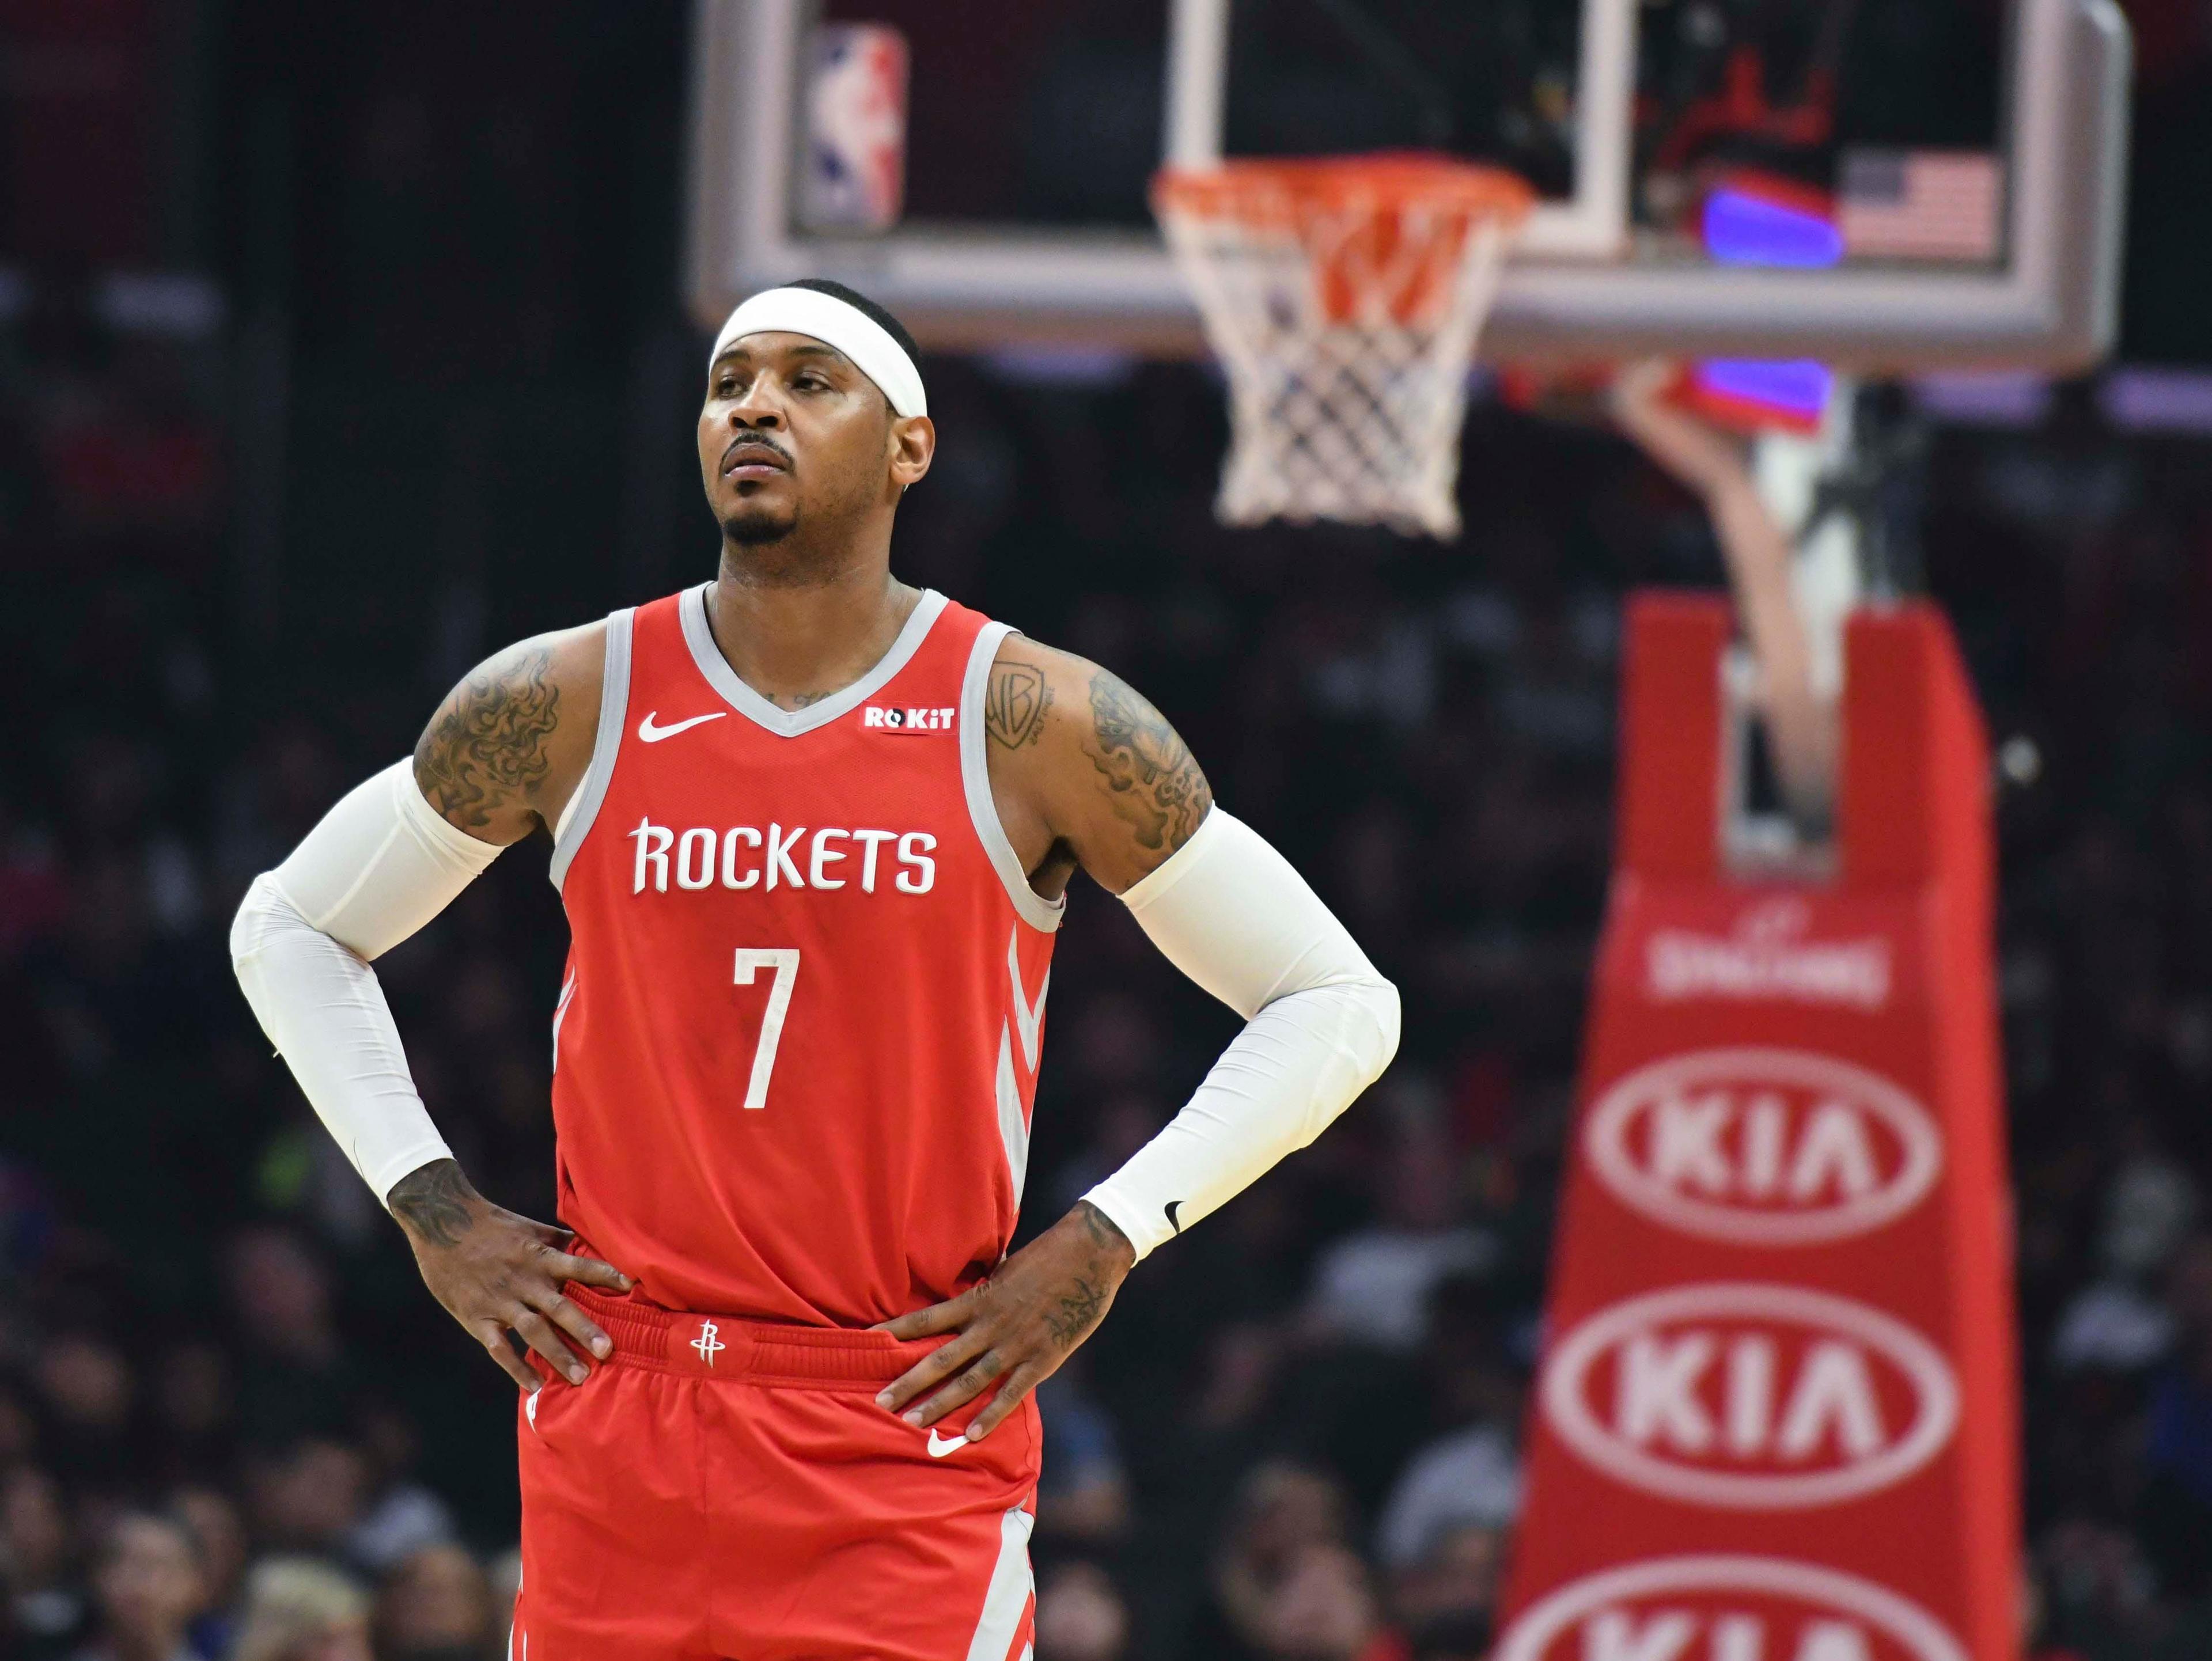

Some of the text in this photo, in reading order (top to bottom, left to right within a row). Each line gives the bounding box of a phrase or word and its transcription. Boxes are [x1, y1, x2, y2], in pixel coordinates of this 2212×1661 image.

[627, 816, 937, 894] ROCKETS
[733, 948, 800, 1109] 7
[1651, 1093, 1879, 1203] KIA
[1618, 1330, 1886, 1461] KIA
